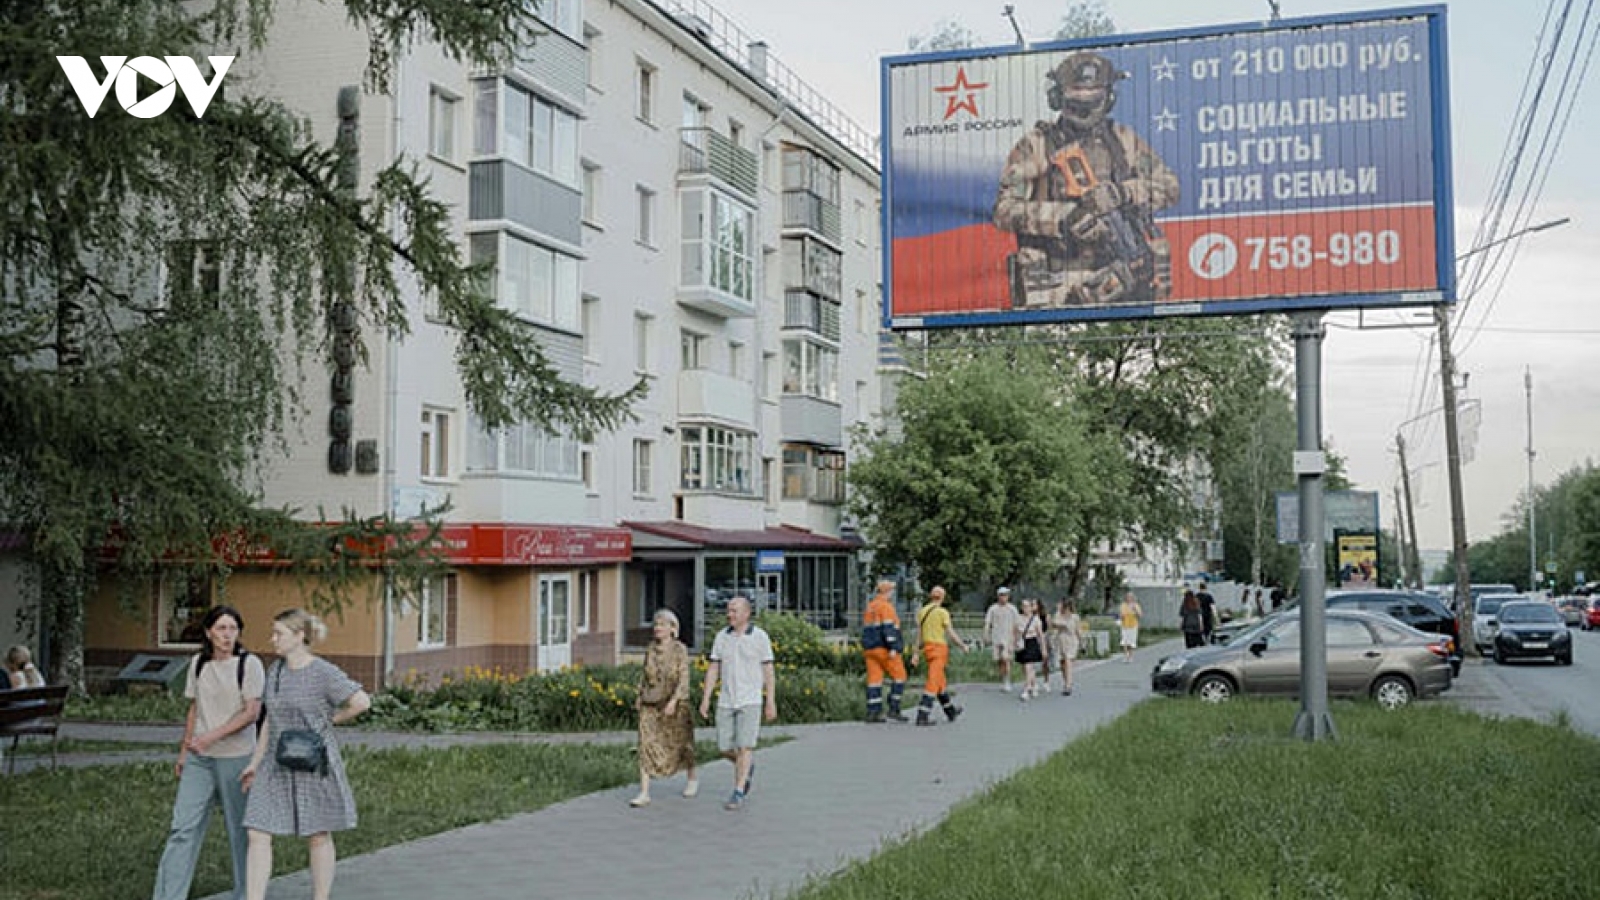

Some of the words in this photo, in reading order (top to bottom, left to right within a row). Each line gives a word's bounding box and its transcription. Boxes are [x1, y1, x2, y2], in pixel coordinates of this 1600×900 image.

[1191, 58, 1222, 80] от
[1231, 47, 1285, 76] 210
[1294, 41, 1349, 71] 000
[1358, 35, 1423, 72] руб.
[902, 123, 960, 138] АРМИЯ
[964, 117, 1024, 132] РОССИИ
[1197, 91, 1407, 134] СОЦИАЛЬНЫЕ
[1197, 133, 1323, 169] ЛЬГОТЫ
[1198, 173, 1264, 210] ДЛЯ
[1272, 166, 1378, 200] СЕМЬИ
[1244, 228, 1400, 271] 758-980
